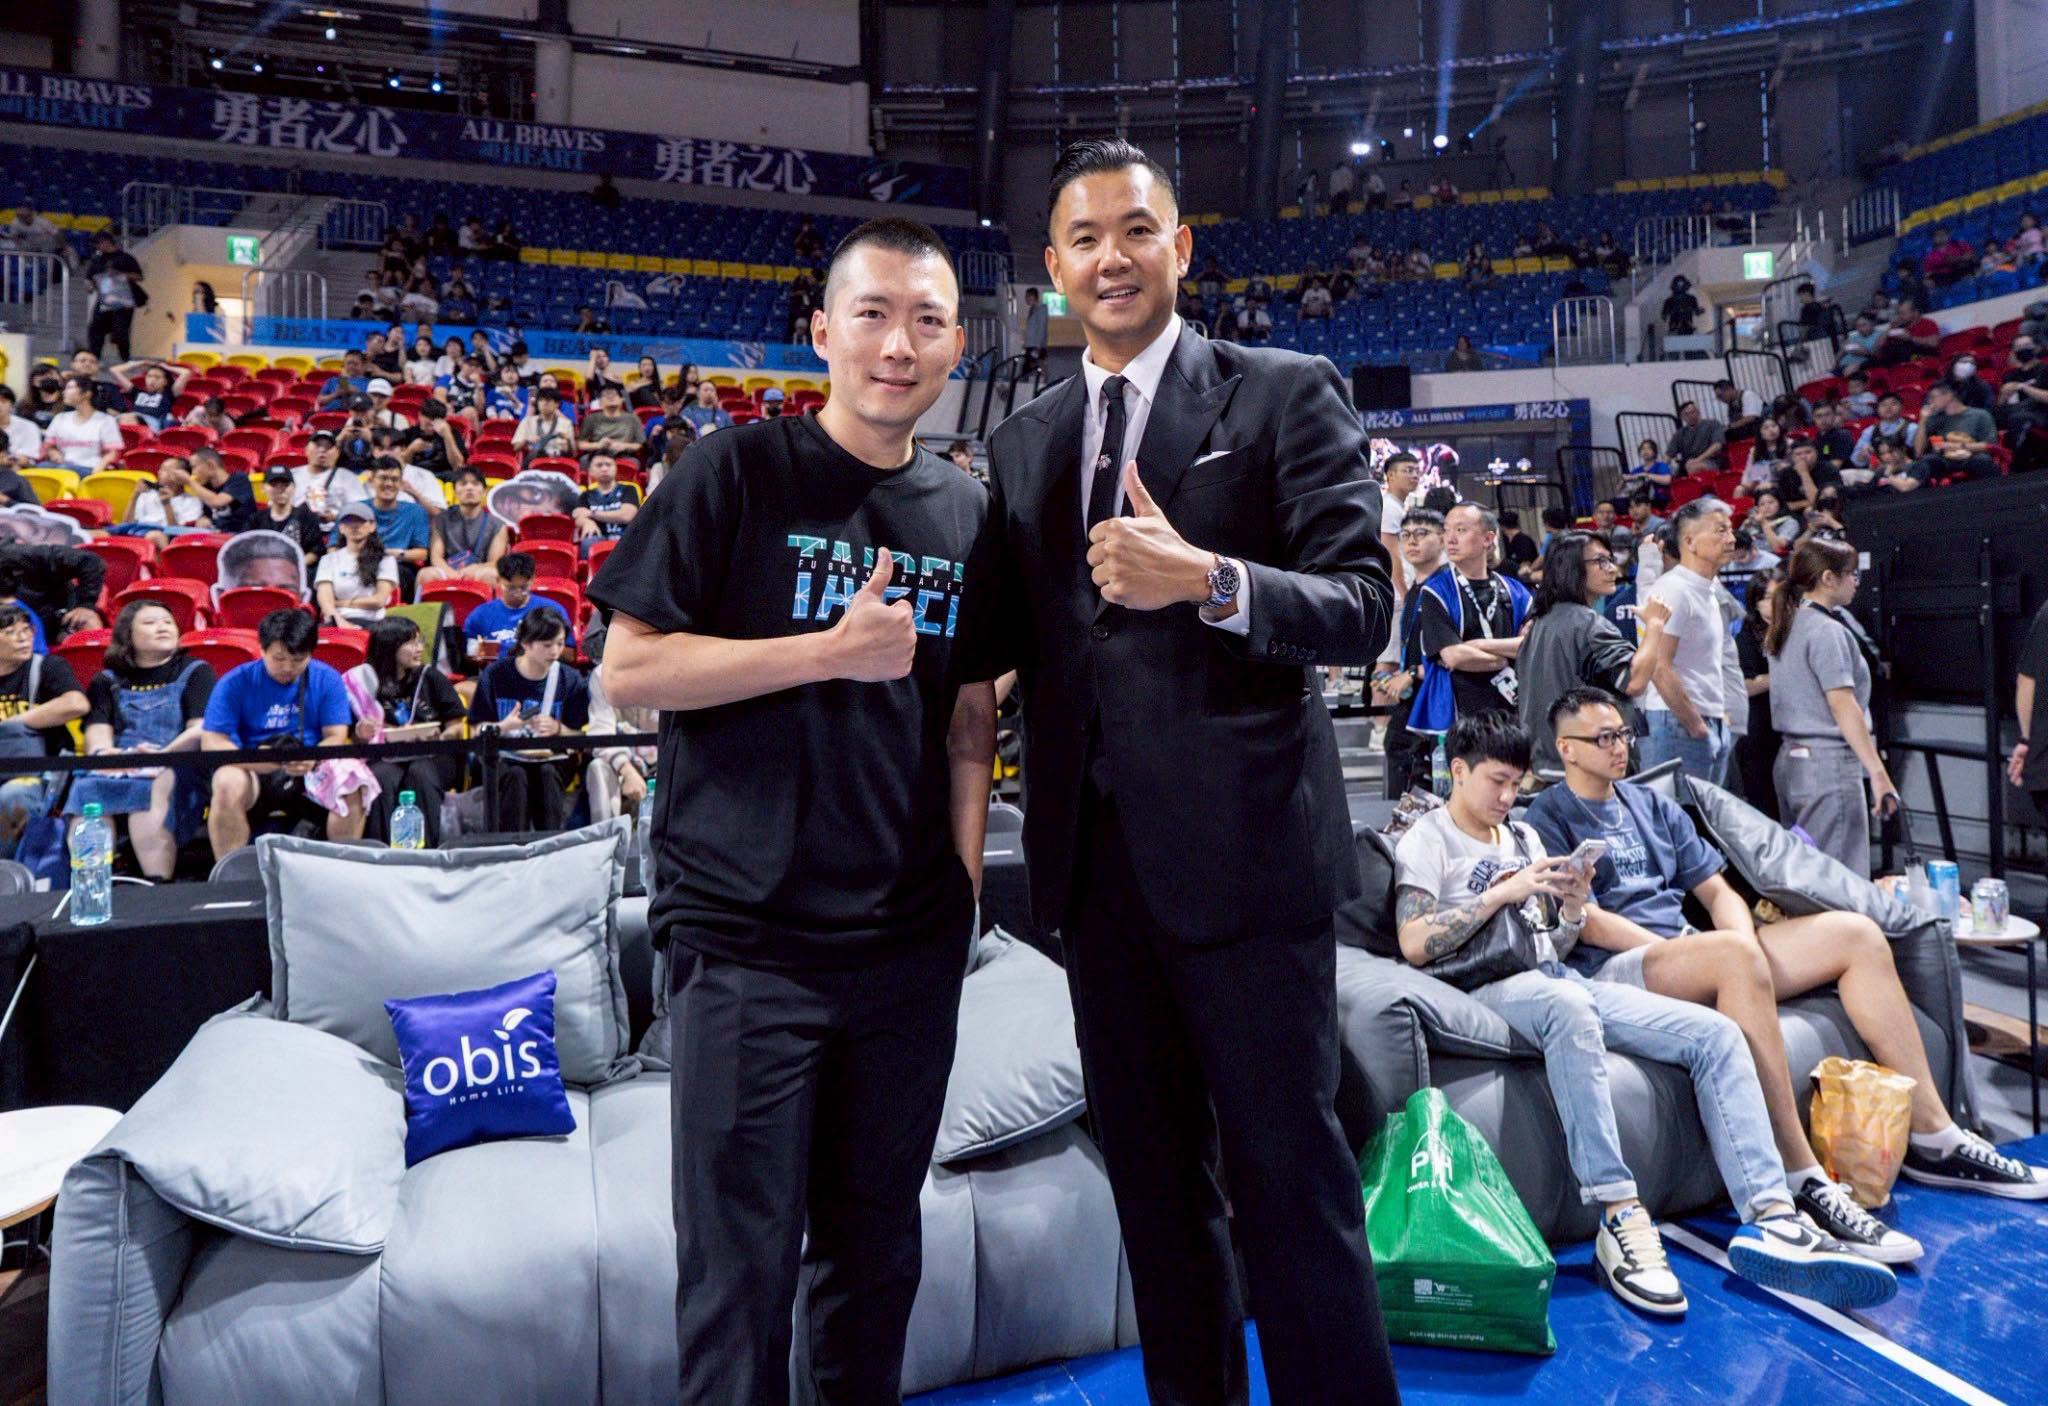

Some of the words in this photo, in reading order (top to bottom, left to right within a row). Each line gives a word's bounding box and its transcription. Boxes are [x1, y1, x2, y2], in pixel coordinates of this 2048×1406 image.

[0, 71, 34, 96] LL
[41, 76, 152, 109] BRAVES
[210, 89, 407, 157] 勇者之心
[460, 120, 511, 143] ALL
[515, 125, 606, 152] BRAVES
[654, 138, 817, 195] 勇者之心
[1514, 401, 1571, 421] 勇者之心
[798, 559, 857, 576] FUBON
[901, 574, 965, 594] RAVES
[423, 1036, 541, 1096] obis
[449, 1090, 488, 1106] Home
[497, 1084, 524, 1096] Life
